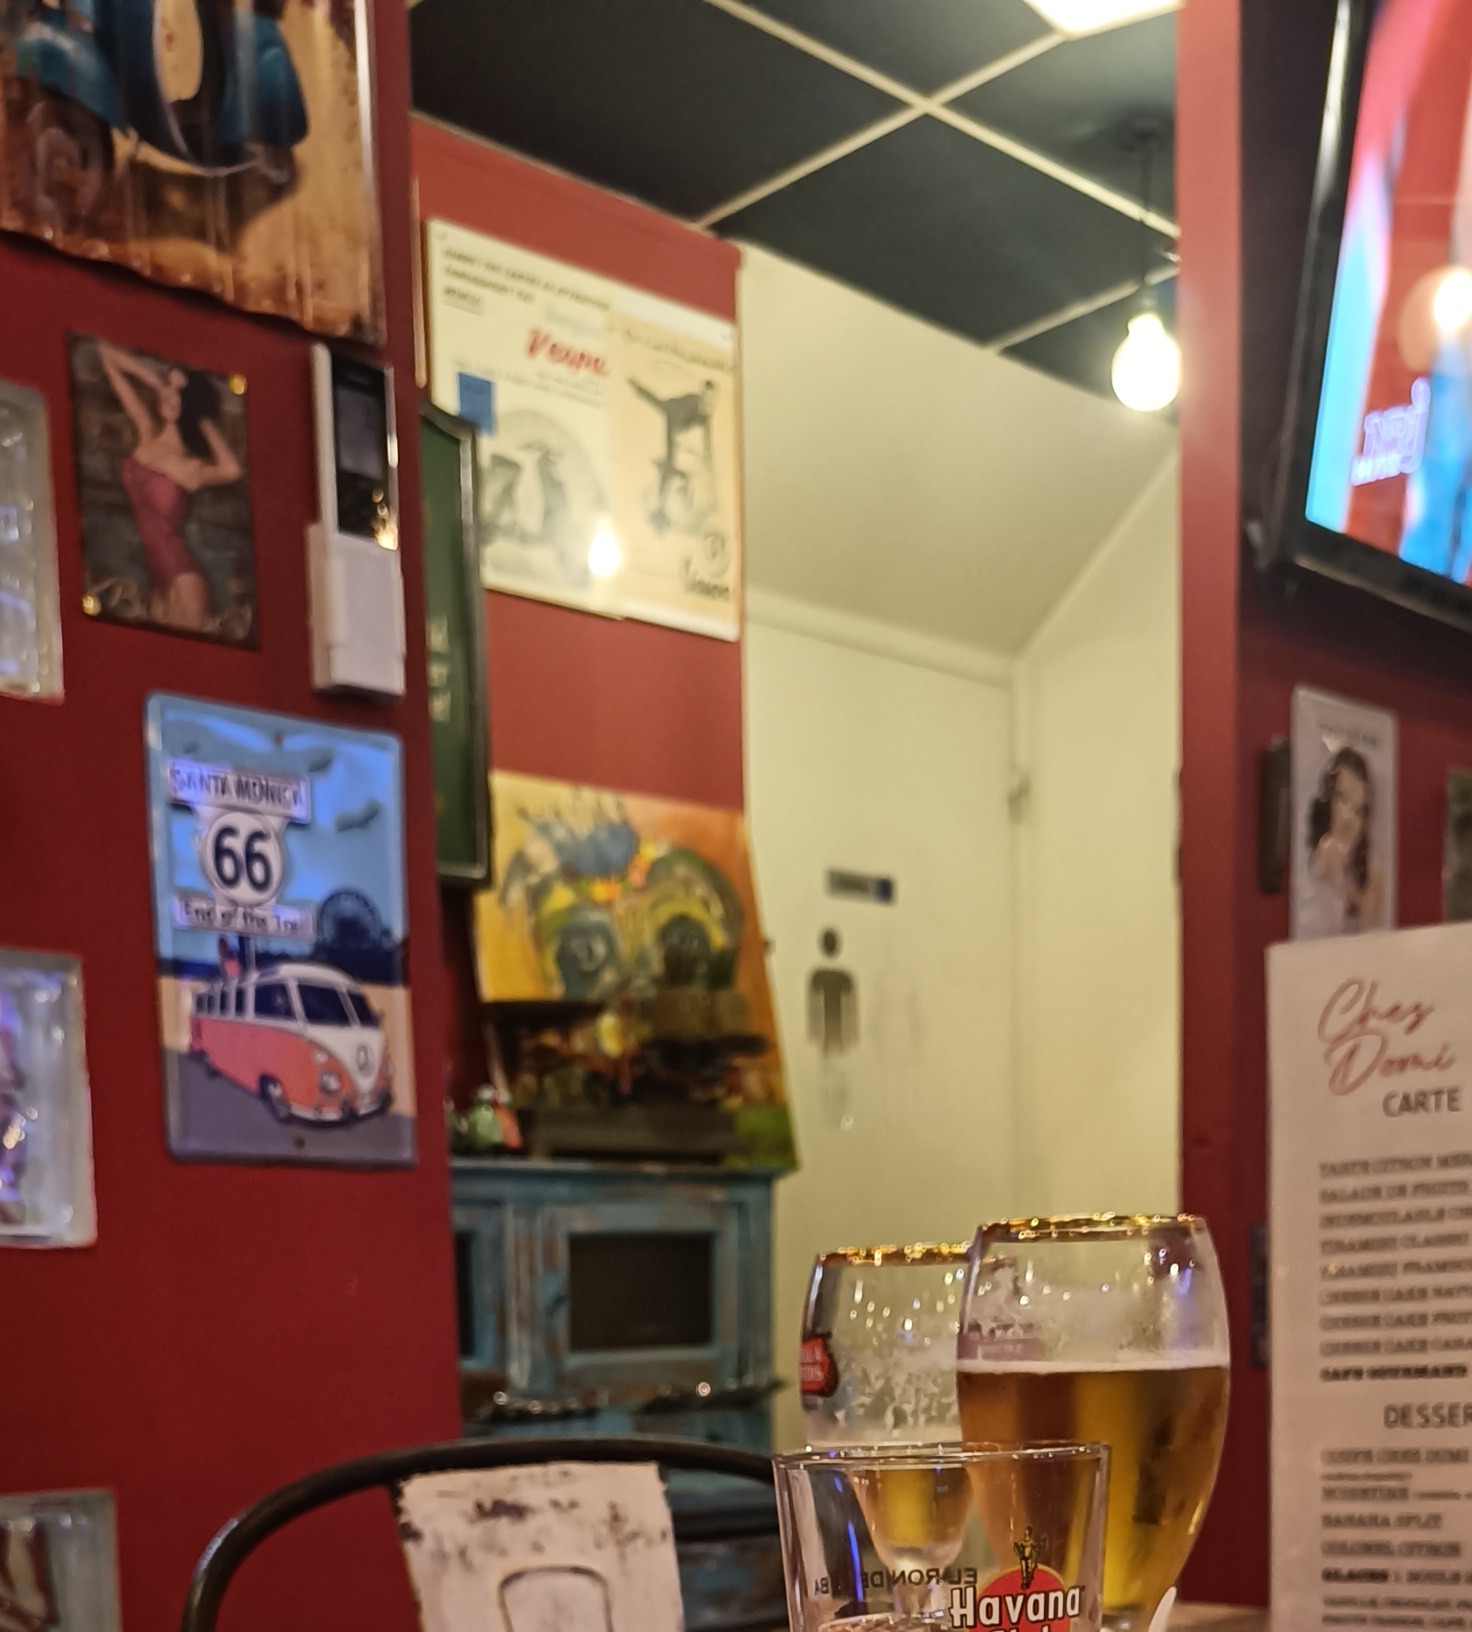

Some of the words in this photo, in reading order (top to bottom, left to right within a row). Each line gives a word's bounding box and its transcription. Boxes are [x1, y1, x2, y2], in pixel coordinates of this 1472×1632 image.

[170, 762, 228, 796] SANTA
[235, 774, 303, 806] MONICA
[213, 825, 272, 891] 66
[1317, 977, 1435, 1043] Chez
[1323, 1030, 1456, 1096] Domi
[1382, 1087, 1463, 1118] CARTE
[948, 1585, 1081, 1629] Havana
